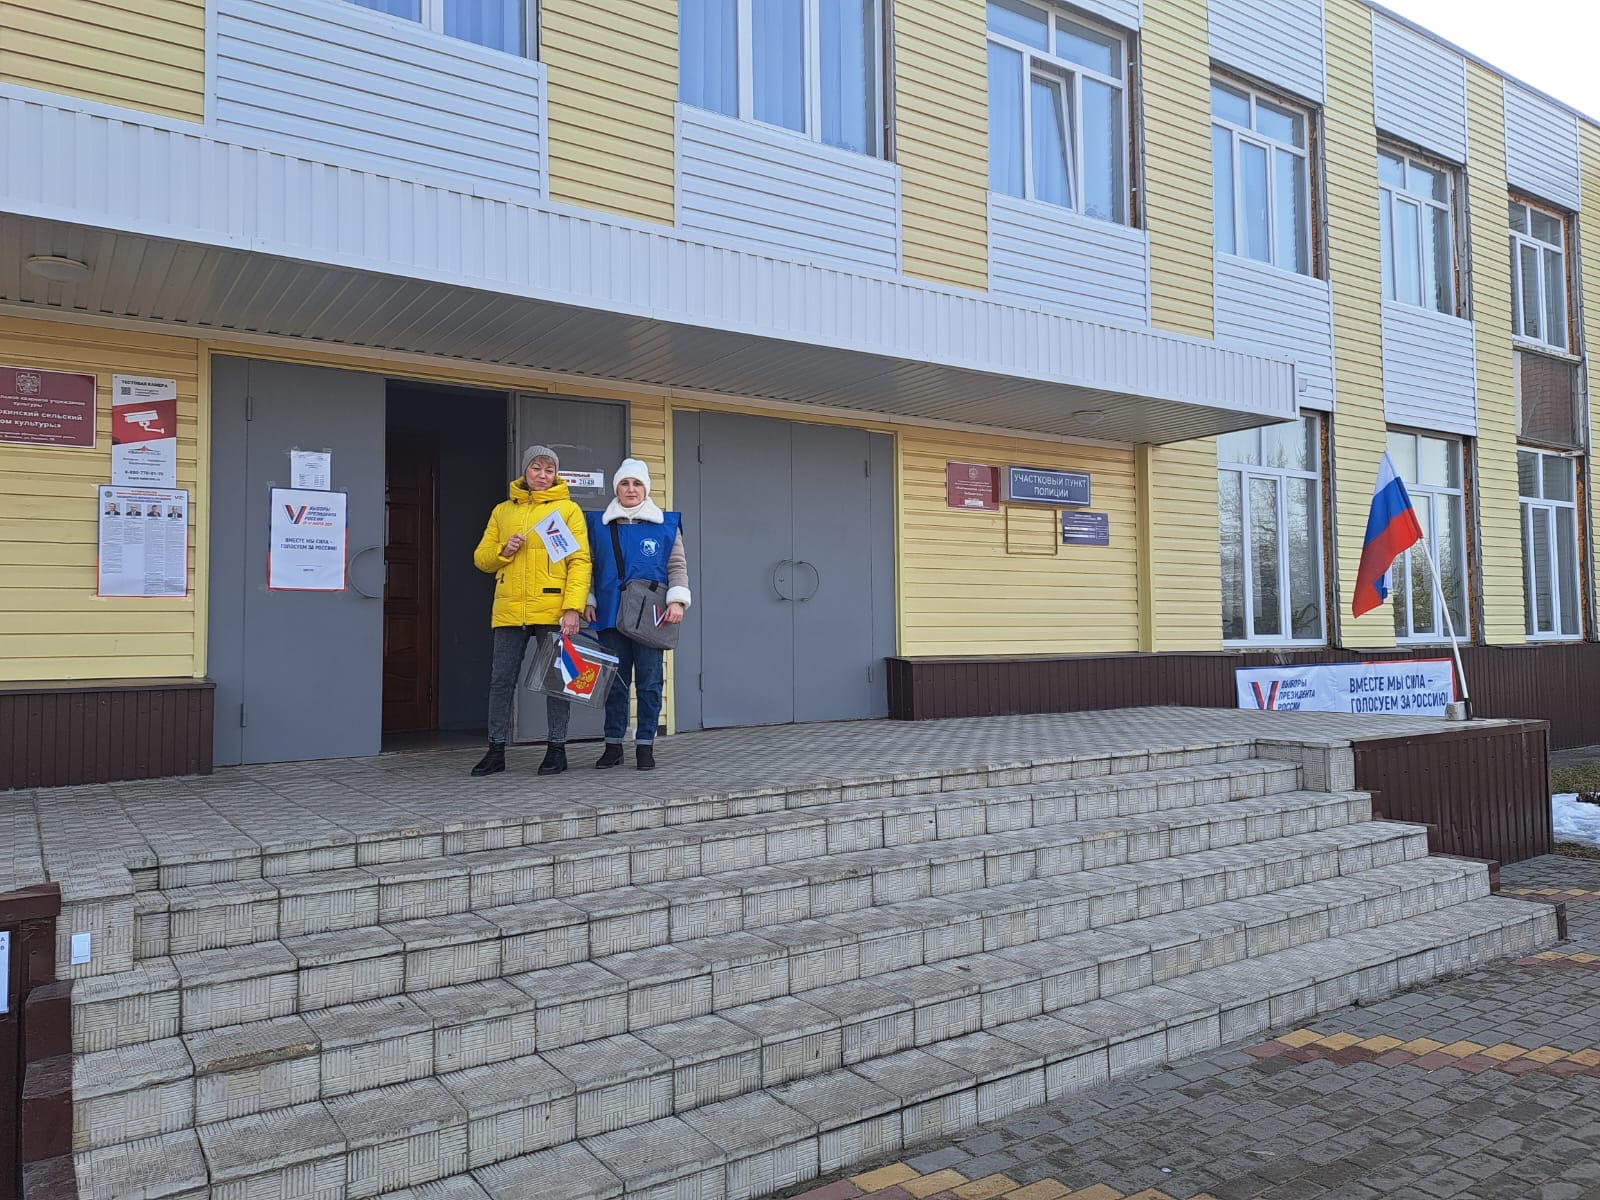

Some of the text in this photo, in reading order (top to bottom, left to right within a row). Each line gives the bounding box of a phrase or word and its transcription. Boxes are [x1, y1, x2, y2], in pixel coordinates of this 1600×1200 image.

[41, 412, 83, 421] сельский
[1014, 473, 1087, 488] УЧАСТКОВЫЙ ПУНКТ
[1034, 486, 1069, 498] ПОЛИЦИИ
[1280, 679, 1307, 689] ВЫБОРЫ
[1349, 676, 1385, 694] ВМЕСТЕ
[1387, 675, 1404, 691] МЫ
[1405, 674, 1426, 689] СИЛА
[1278, 689, 1316, 700] ПРЕЗИДЕНТА
[1277, 702, 1301, 711] РОССИИ
[1350, 691, 1448, 714] ГОЛОСУЕМ ЗА РОССИЮ!
